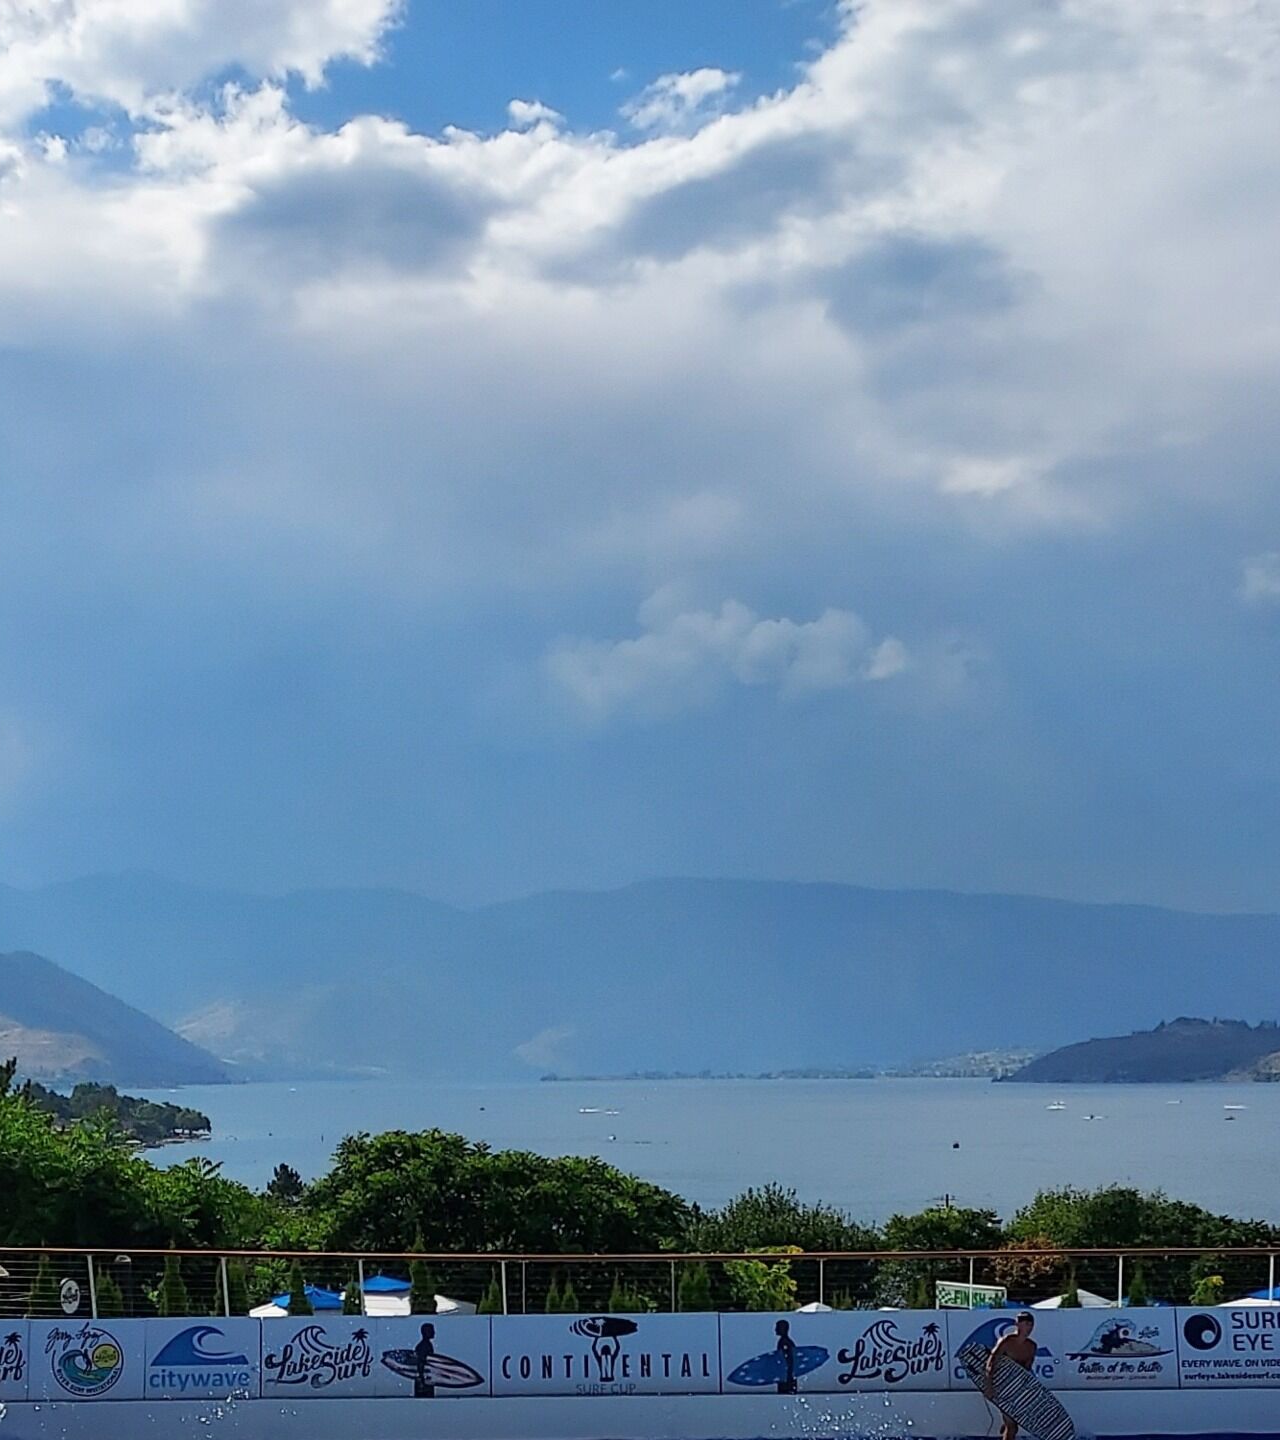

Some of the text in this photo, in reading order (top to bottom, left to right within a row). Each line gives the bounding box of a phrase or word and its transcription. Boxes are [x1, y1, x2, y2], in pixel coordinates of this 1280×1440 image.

[1232, 1334, 1275, 1351] EYE
[502, 1353, 710, 1379] CONTINENTAL
[1181, 1358, 1211, 1368] EVERY
[1245, 1358, 1259, 1368] ON
[149, 1369, 250, 1392] citywave
[576, 1383, 637, 1395] SURF CUP
